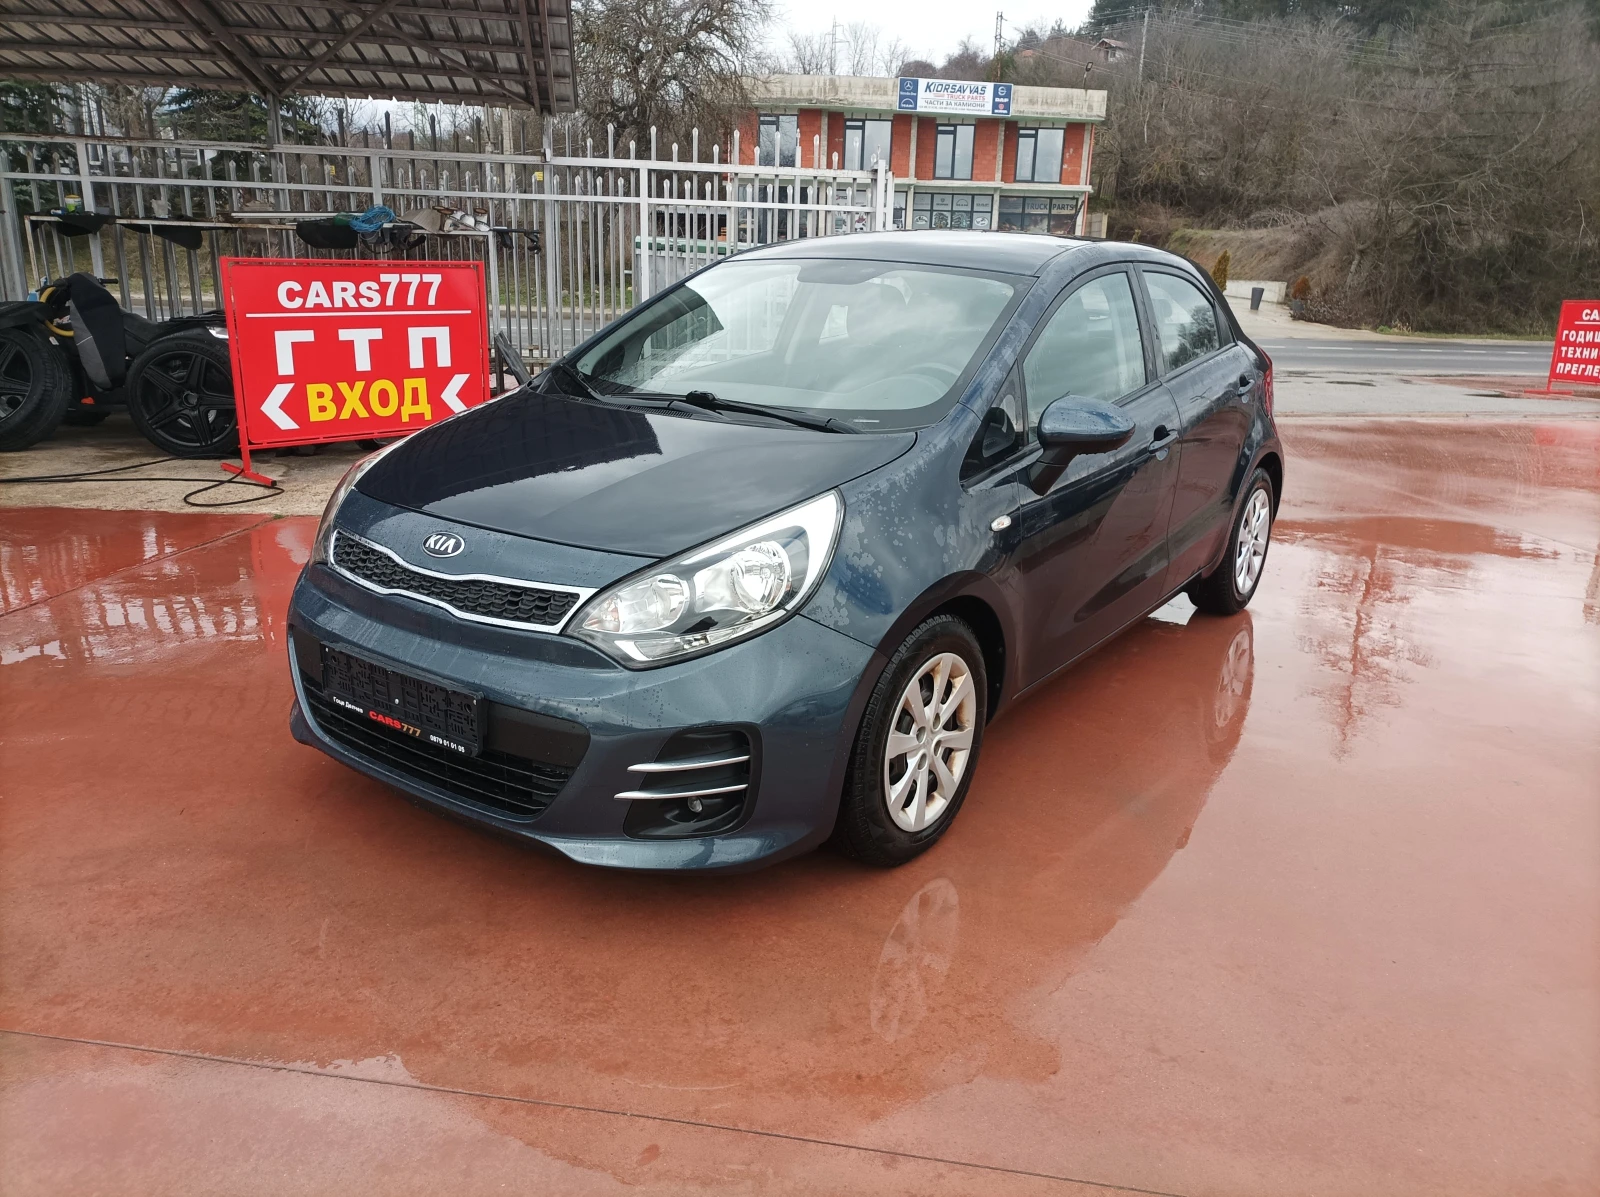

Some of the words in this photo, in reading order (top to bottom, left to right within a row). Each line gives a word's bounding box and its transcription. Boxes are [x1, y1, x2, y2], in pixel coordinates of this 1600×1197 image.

[924, 81, 987, 95] KIORSAVVAS
[1026, 202, 1049, 210] TRUCK
[1052, 203, 1074, 211] PARTS
[277, 273, 442, 309] CARS777
[1561, 346, 1600, 360] ТЕХНИ
[1556, 362, 1600, 379] ПРЕГЛЕ
[306, 377, 432, 423] ВХОД
[425, 534, 456, 553] KIA
[369, 710, 421, 737] CARS777
